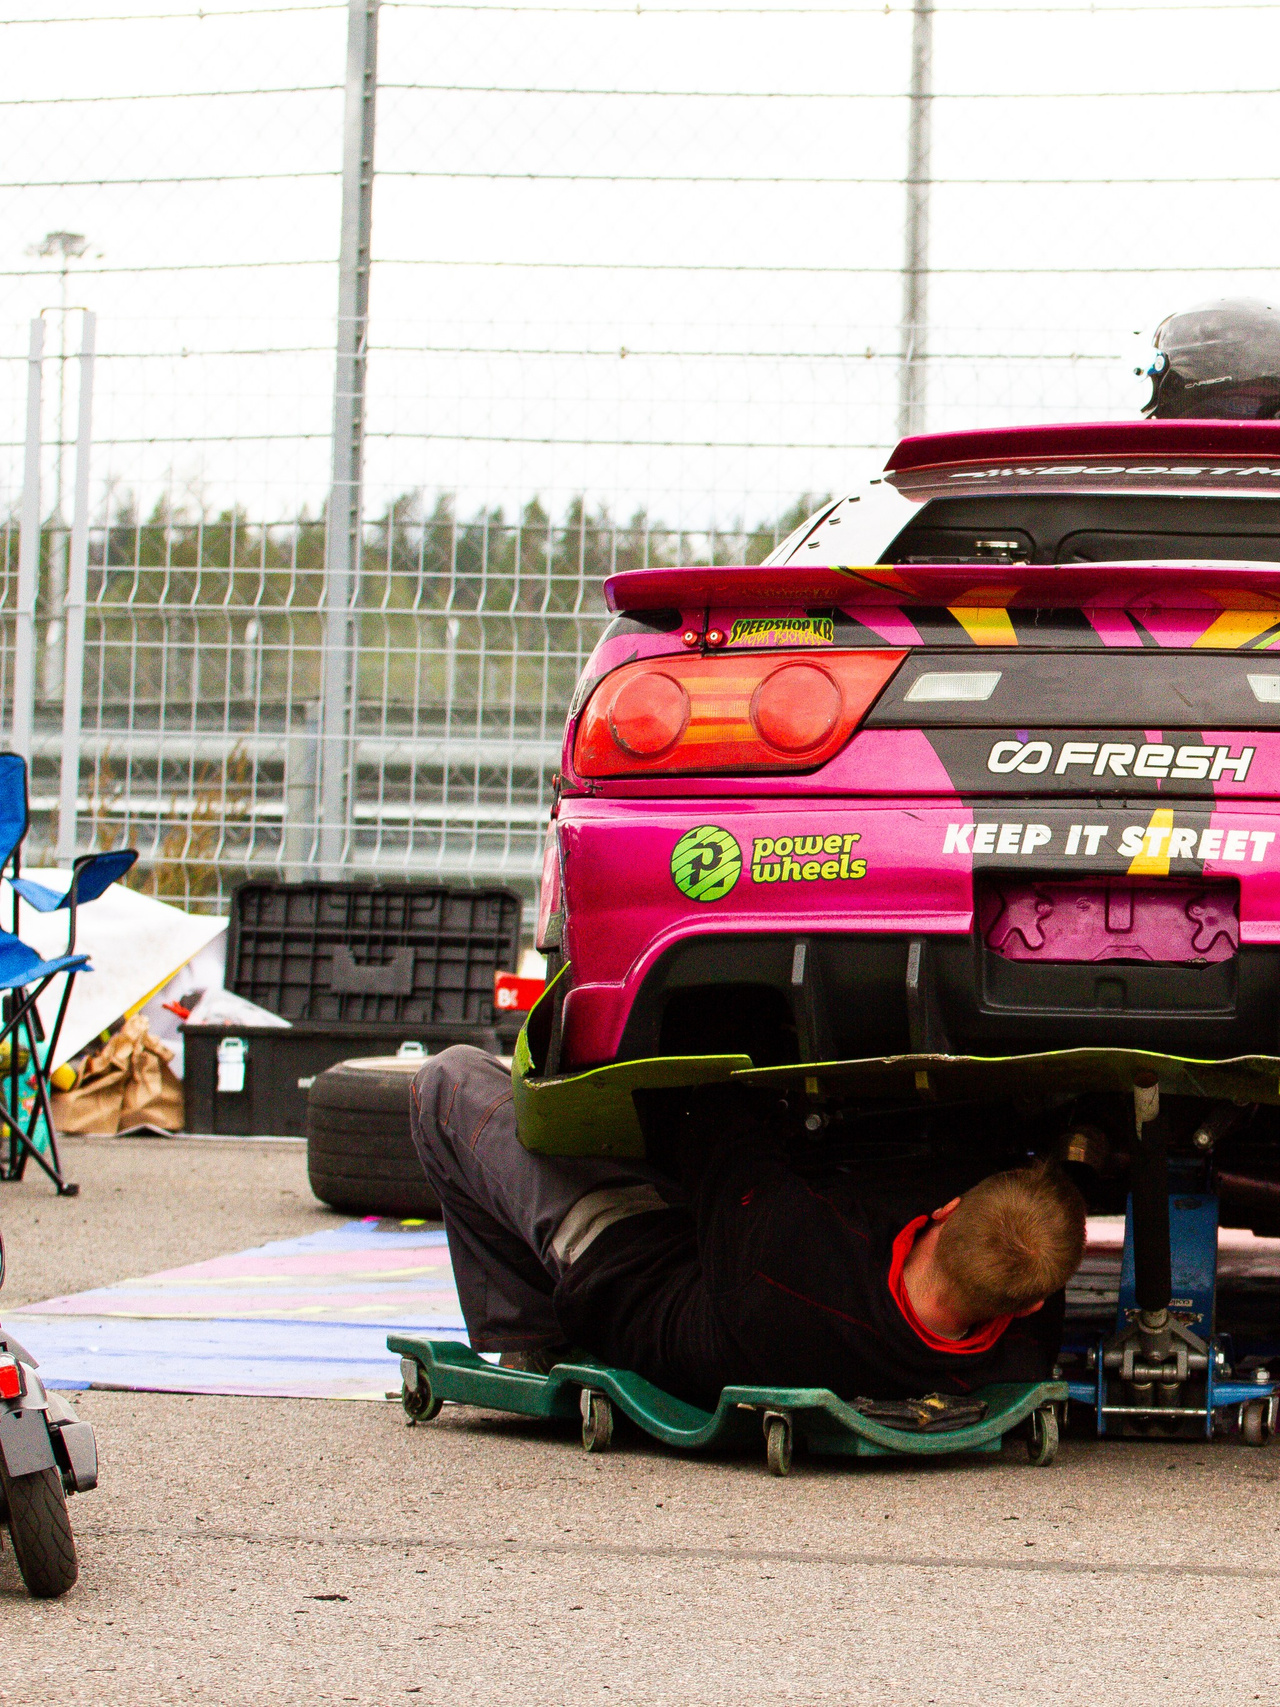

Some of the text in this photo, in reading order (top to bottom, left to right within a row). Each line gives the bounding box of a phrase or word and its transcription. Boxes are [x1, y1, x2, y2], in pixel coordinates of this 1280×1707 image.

[753, 833, 861, 863] power
[942, 823, 1276, 862] KEEP IT STREET
[752, 855, 868, 883] wheels
